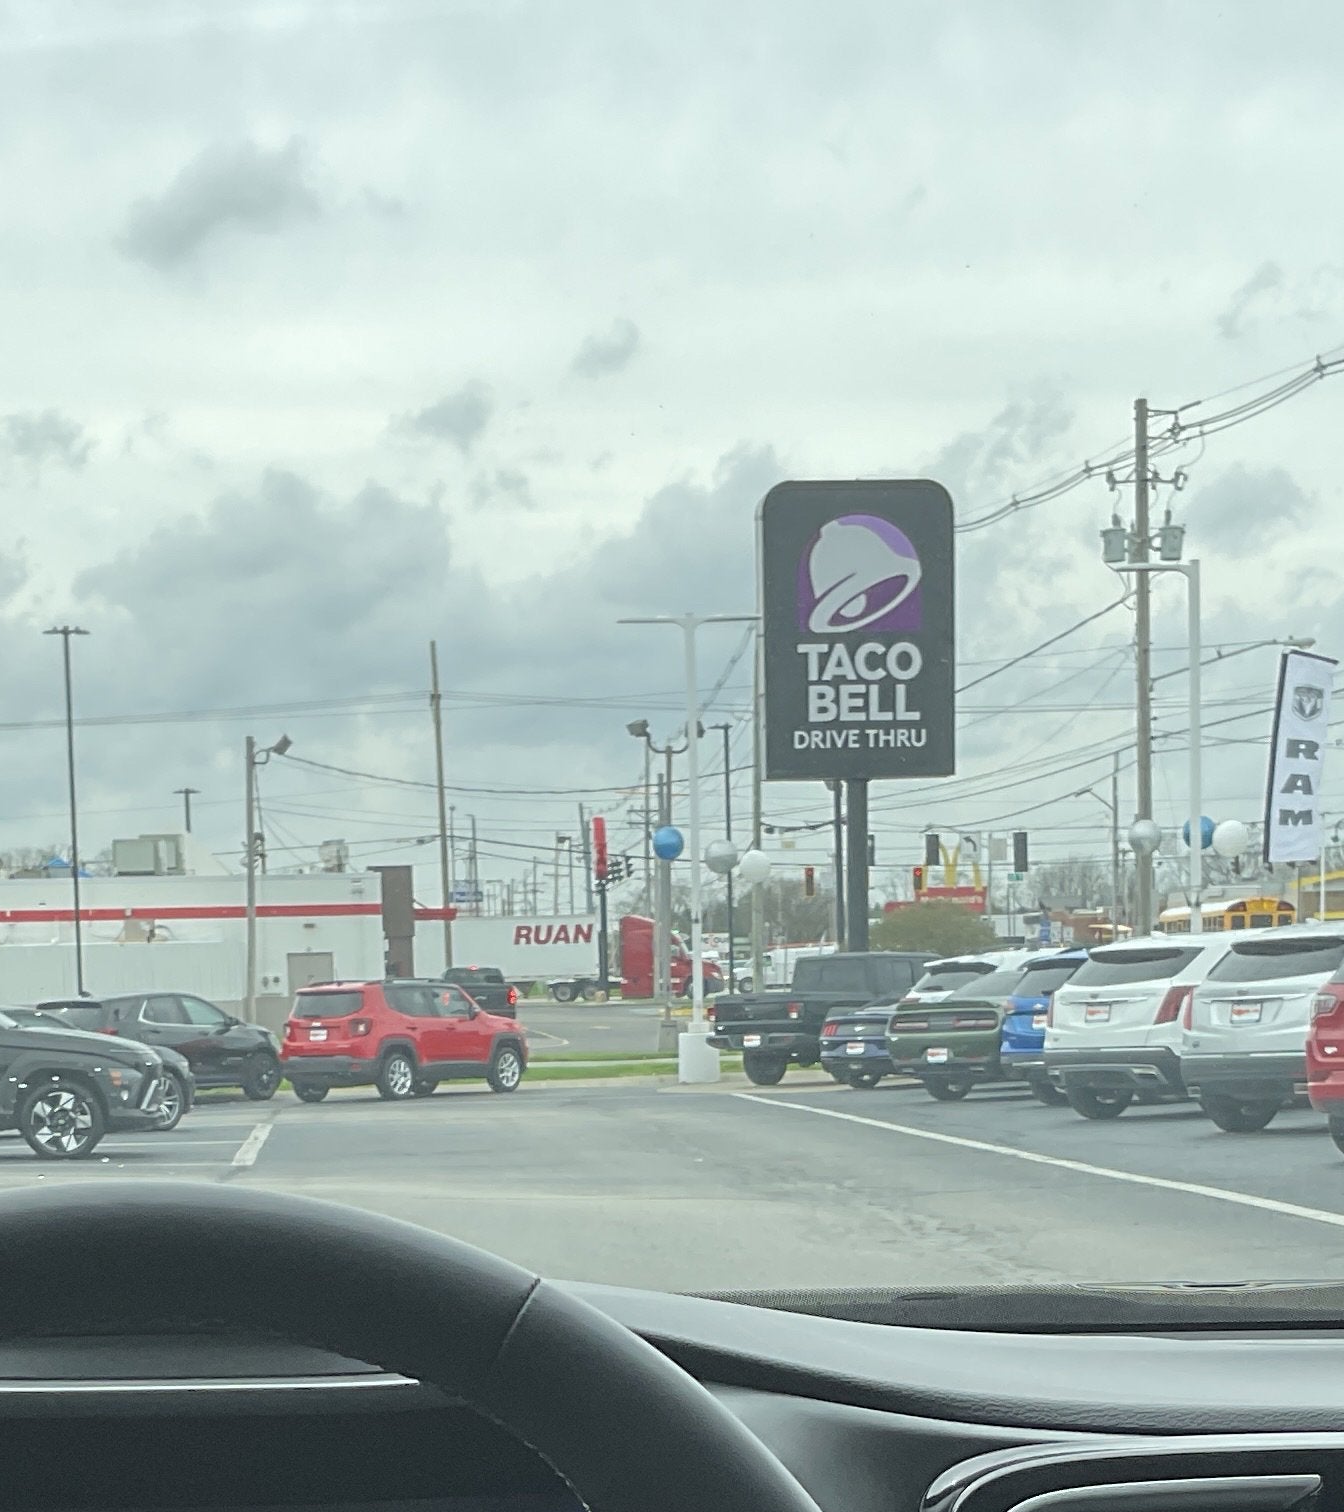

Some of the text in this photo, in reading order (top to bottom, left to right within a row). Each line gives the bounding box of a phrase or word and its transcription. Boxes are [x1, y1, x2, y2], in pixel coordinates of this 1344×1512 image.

[796, 641, 922, 682] TACO
[808, 684, 921, 722] BELL
[793, 728, 927, 749] DRIVE THRU
[1278, 737, 1320, 827] RAM
[513, 923, 594, 945] RUAN
